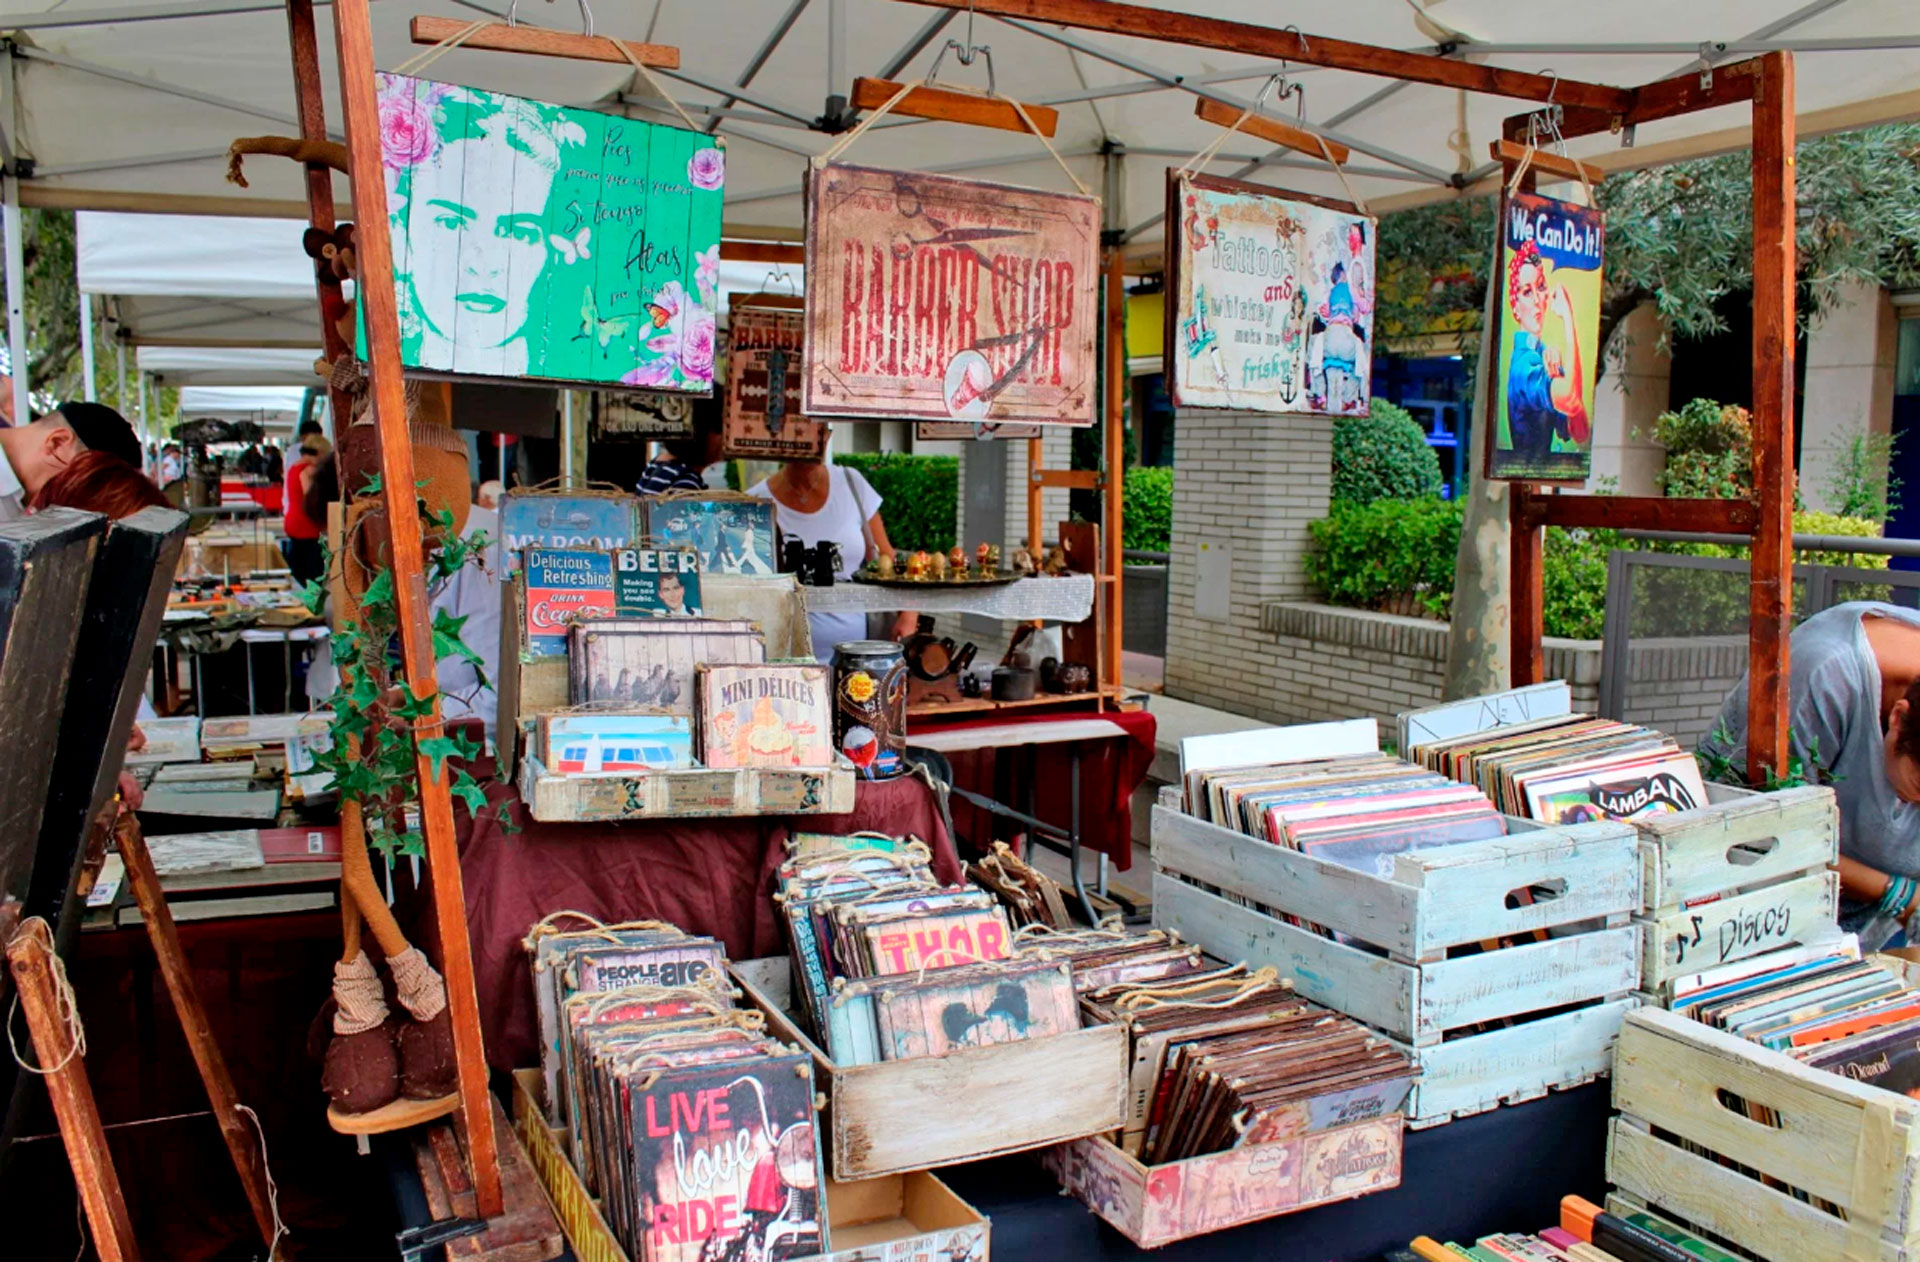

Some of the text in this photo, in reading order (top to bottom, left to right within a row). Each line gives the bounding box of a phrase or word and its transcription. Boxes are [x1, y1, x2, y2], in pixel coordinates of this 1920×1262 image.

[1511, 206, 1600, 259] We Can Do It!
[623, 228, 682, 277] Alas
[1209, 230, 1297, 279] Tattoos
[1263, 275, 1294, 302] and
[841, 240, 1074, 387] BARBER SHOP
[1210, 294, 1275, 328] whiskey
[1241, 352, 1292, 389] frisky
[531, 552, 592, 570] Delicious
[543, 569, 613, 588] Refreshing
[618, 550, 698, 573] BEER
[550, 593, 585, 602] DRINK
[622, 579, 654, 588] Making
[721, 673, 815, 708] MINI DÉLICES
[880, 921, 1004, 974] THOR
[1718, 899, 1791, 963] Discos
[597, 960, 711, 988] PEOPLE are
[645, 1087, 732, 1139] LIVE
[673, 1127, 758, 1199] love
[652, 1194, 741, 1248] RIDE
